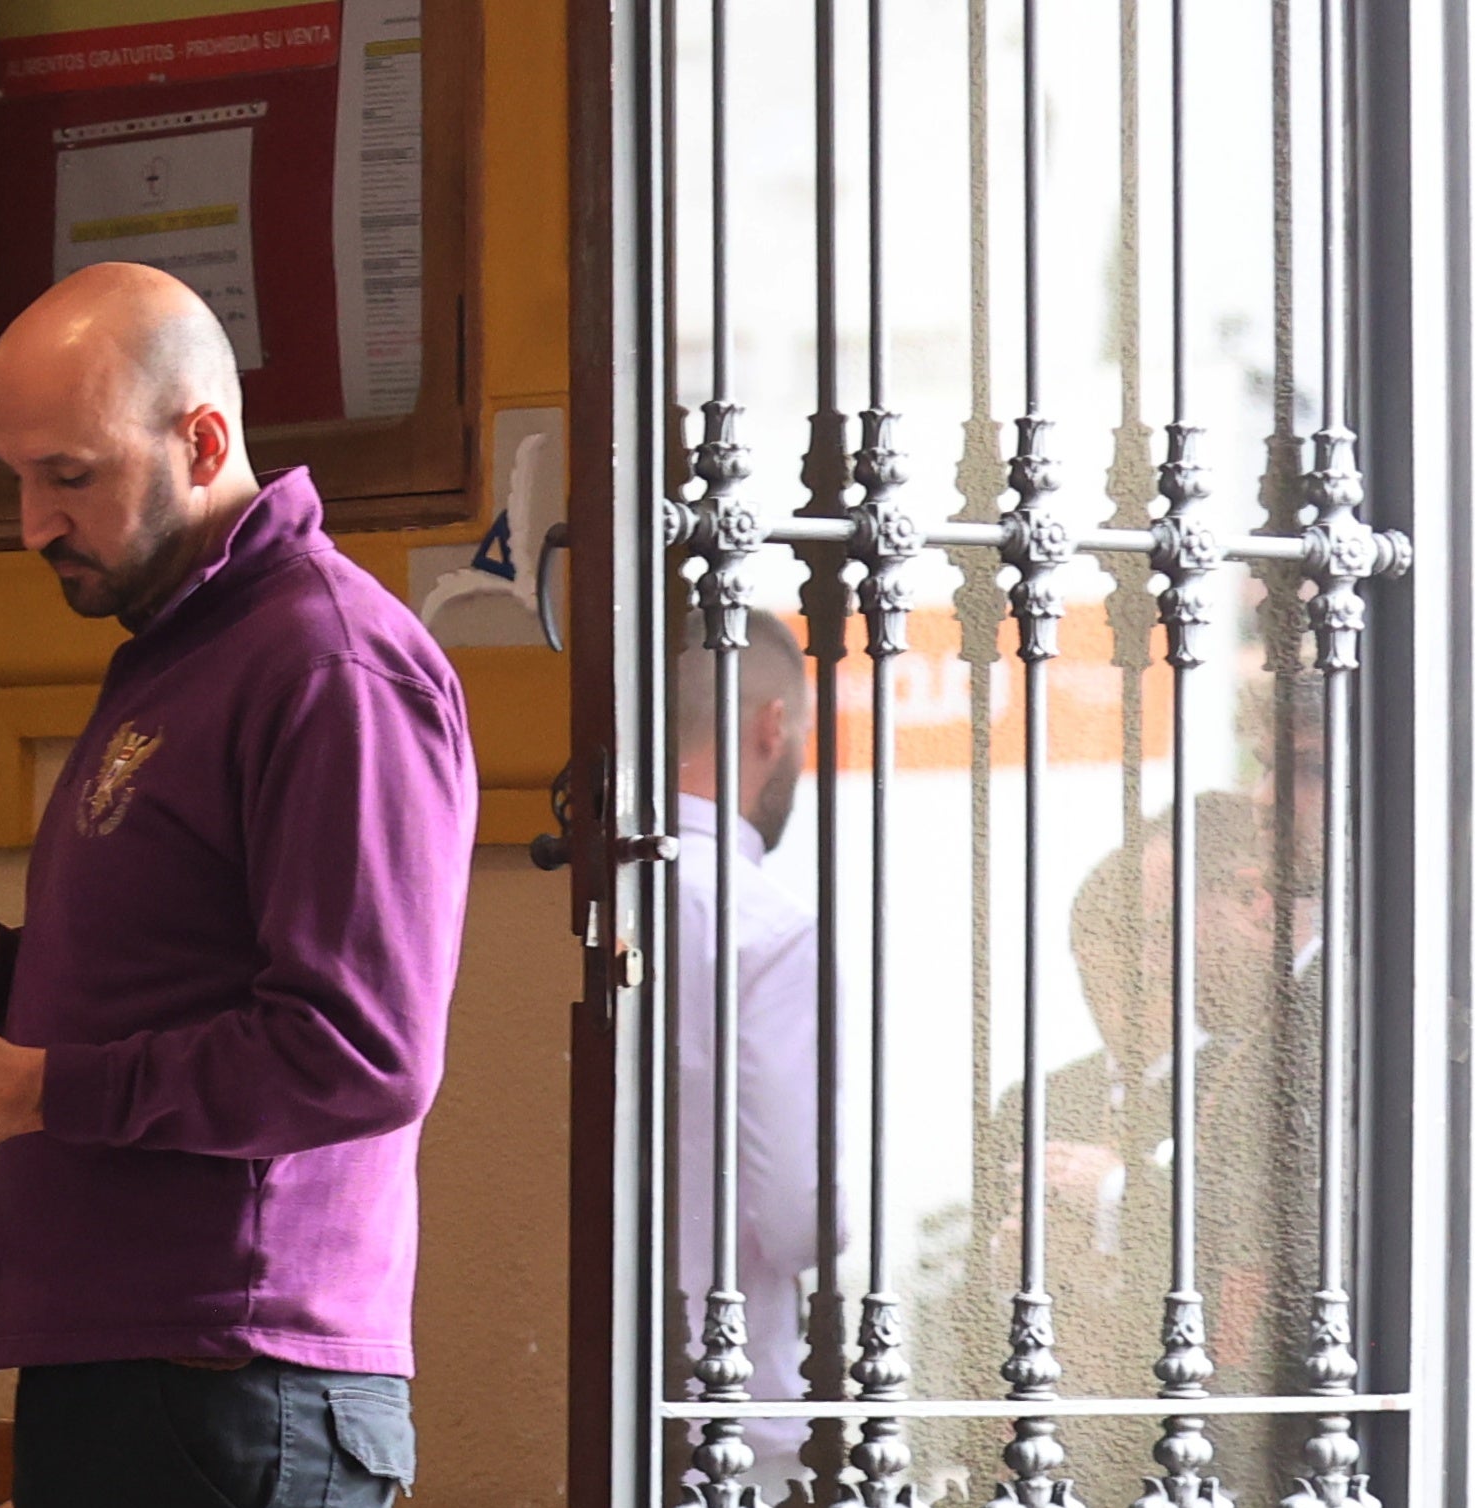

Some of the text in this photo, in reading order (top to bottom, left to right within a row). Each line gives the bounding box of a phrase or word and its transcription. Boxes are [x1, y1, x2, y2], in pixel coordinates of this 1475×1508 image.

[88, 43, 176, 68] GRATUITOS
[262, 28, 282, 49] SU
[284, 24, 331, 46] VENTA
